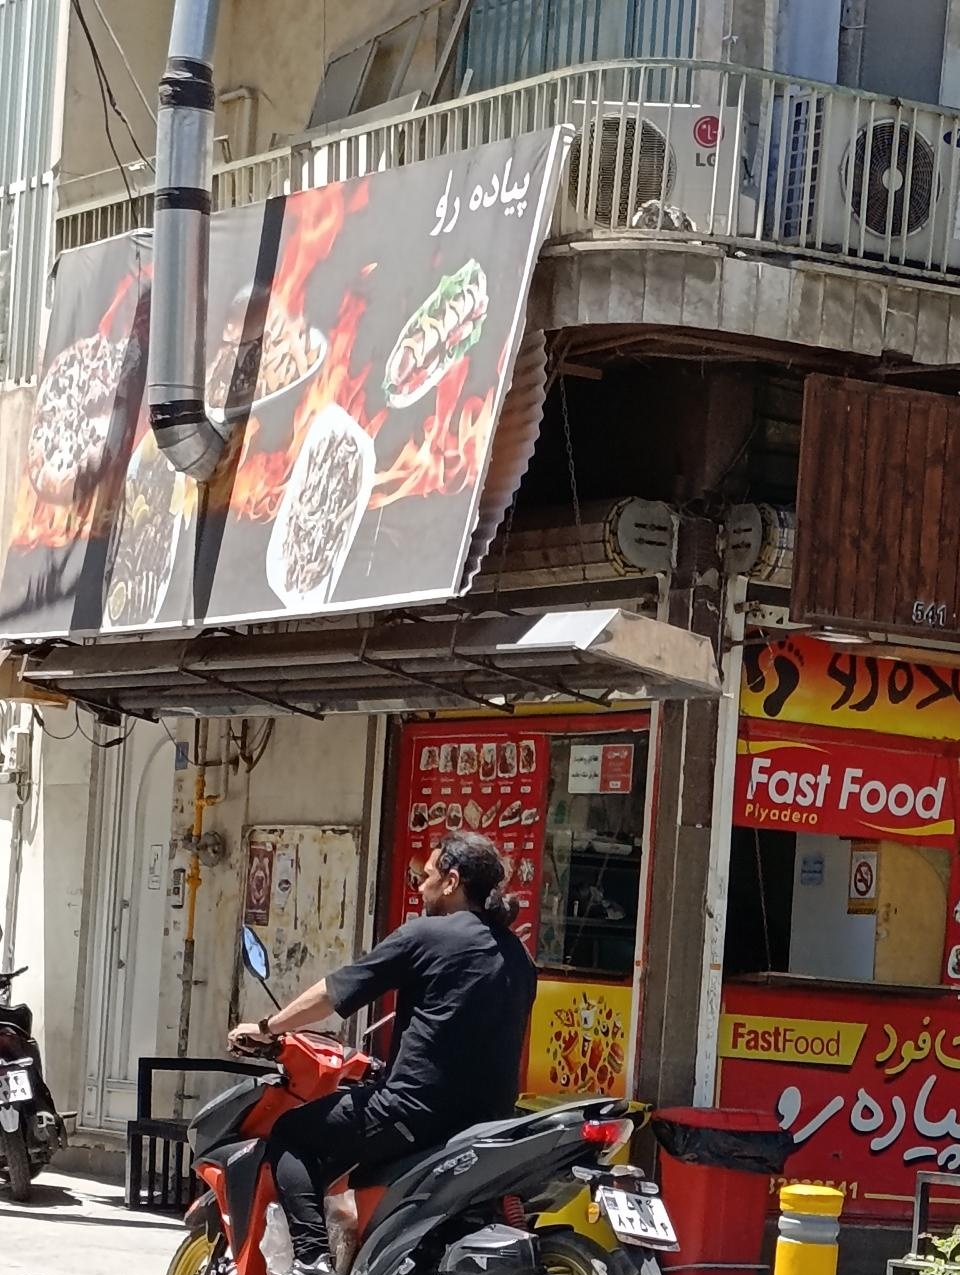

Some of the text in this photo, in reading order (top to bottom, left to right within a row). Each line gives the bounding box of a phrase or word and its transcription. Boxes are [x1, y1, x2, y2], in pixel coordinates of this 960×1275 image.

[468, 157, 531, 218] پیاده
[911, 600, 947, 627] 541
[744, 802, 819, 825] Piyadero
[746, 757, 946, 820] Fast Food
[875, 1016, 932, 1075] فود
